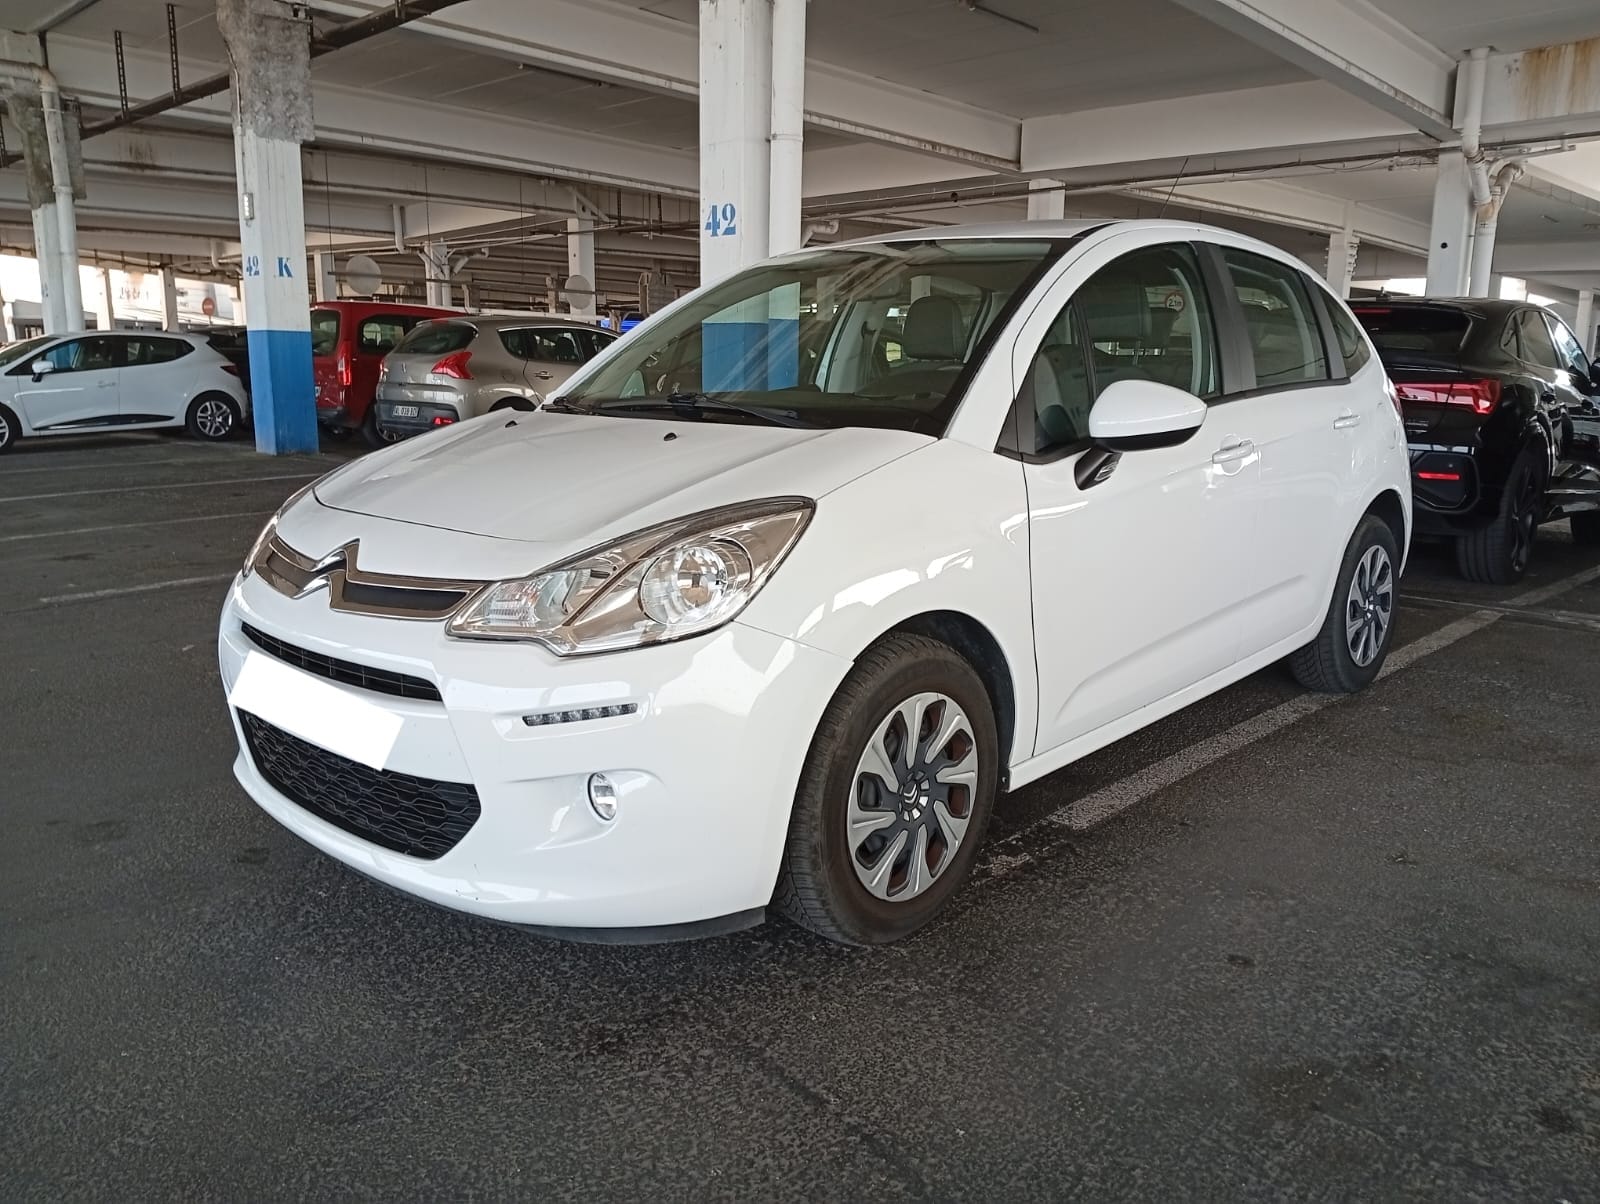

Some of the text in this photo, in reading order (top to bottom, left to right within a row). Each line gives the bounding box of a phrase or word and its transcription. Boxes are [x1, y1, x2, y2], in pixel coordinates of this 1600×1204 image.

[704, 203, 737, 237] 42
[246, 256, 260, 277] 42
[277, 256, 293, 278] K
